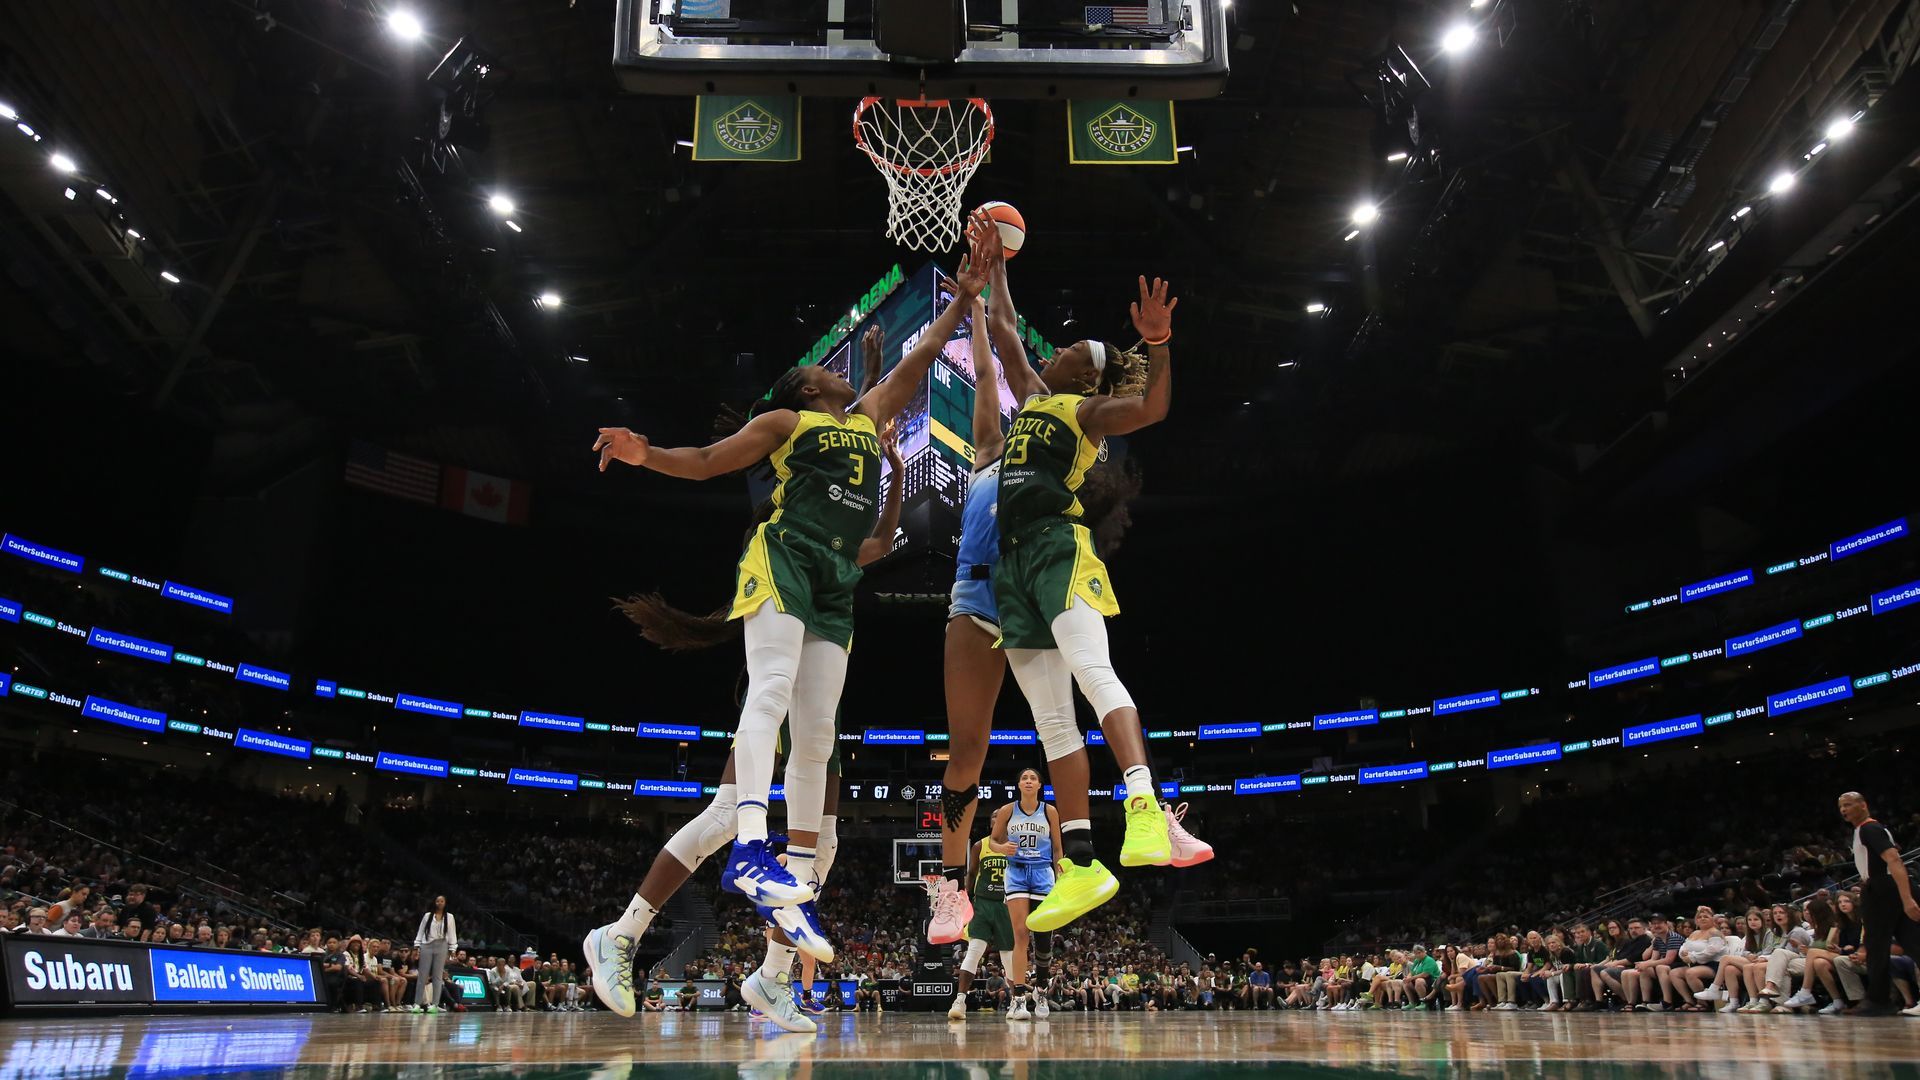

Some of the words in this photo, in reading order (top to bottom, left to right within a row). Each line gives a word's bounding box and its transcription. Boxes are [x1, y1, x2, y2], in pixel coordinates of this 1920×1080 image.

[718, 123, 750, 150] SEATTLE
[754, 124, 778, 149] STORM
[1092, 126, 1126, 152] SEATTLE
[1131, 126, 1152, 150] STORM
[934, 360, 951, 389] LIVE
[1003, 434, 1032, 468] 23
[848, 453, 864, 486] 3
[842, 498, 865, 511] SWEDISH
[844, 488, 872, 506] Providence
[893, 536, 909, 551] ETRA
[1836, 526, 1902, 553] CarterSubaru.com
[9, 541, 78, 566] CarterSubaru.com
[1767, 562, 1797, 573] CARTER
[1800, 552, 1827, 565] Subaru
[102, 569, 127, 580] CARTER
[132, 576, 160, 589] Subaru
[1686, 576, 1748, 596] CarterSubaru.com
[169, 587, 228, 608] CarterSubaru.com
[1630, 602, 1648, 611] ARTER
[1653, 595, 1677, 605] Subaru
[1879, 588, 1920, 606] CarterSub
[1806, 616, 1831, 629] CARTER
[1836, 605, 1867, 619] Subaru
[26, 614, 52, 626] CARTER
[57, 622, 86, 637] Subaru
[96, 634, 166, 656] CarterSubaru.com
[1732, 627, 1796, 650] CarterSubaru.com
[175, 654, 202, 664] CARTER
[206, 660, 235, 673] Subaru
[1661, 656, 1690, 666] CARTER
[1693, 648, 1722, 659] Subaru
[1595, 664, 1654, 682] CarterSubaru.com
[1857, 674, 1887, 687] CARTER
[1892, 664, 1920, 678] Subaru
[15, 683, 44, 697] CARTER
[49, 692, 80, 707] Subaru
[339, 689, 363, 697] CARTER
[368, 693, 393, 703] Subaru
[1504, 690, 1528, 698] CARTER
[1774, 685, 1846, 708] CarterSubaru.com
[402, 699, 458, 713] CarterSubaru.com
[1439, 696, 1495, 709] CarterSubaru.com
[91, 703, 160, 725] CarterSubaru.com
[493, 711, 517, 720] Subaru
[1407, 706, 1430, 715] Subaru
[1705, 713, 1731, 724] CARTER
[1736, 706, 1764, 718] Subaru
[526, 716, 579, 727] CarterSubaru.com
[1288, 721, 1311, 729] Subaru
[1319, 715, 1373, 725] CarterSubaru.com
[171, 722, 198, 731] CARTER
[203, 727, 232, 739] Subaru
[612, 724, 635, 732] Subaru
[643, 726, 696, 735] CarterSubaru.com
[1204, 727, 1257, 735] CarterSubaru.com
[1629, 722, 1697, 739] CarterSubaru.com
[243, 735, 305, 752] CarterSubaru.com
[1592, 737, 1619, 747] Subaru
[315, 748, 343, 757] CARTER
[346, 752, 373, 762] Subaru
[1458, 758, 1484, 767] Subaru
[1493, 749, 1556, 762] CarterSubaru.com
[383, 757, 443, 771] CarterSubaru.com
[479, 770, 505, 779] Subaru
[515, 774, 573, 784] CarterSubaru.com
[1330, 774, 1355, 782] Subaru
[1364, 768, 1423, 778] CarterSubaru.com
[607, 781, 631, 790] Subaru
[640, 783, 697, 792] CarterSubaru.com
[874, 785, 889, 799] 67
[924, 785, 942, 795] 7:23
[1088, 788, 1111, 796] Subaru
[1207, 784, 1231, 792] Subaru
[1240, 780, 1296, 789] CarterSubaru.com
[977, 786, 992, 799] 55
[922, 812, 942, 828] 24
[1019, 835, 1036, 848] 20
[24, 951, 133, 991] Subaru
[165, 962, 228, 989] Ballard
[239, 966, 305, 992] Shoreline
[916, 985, 950, 993] BECU
